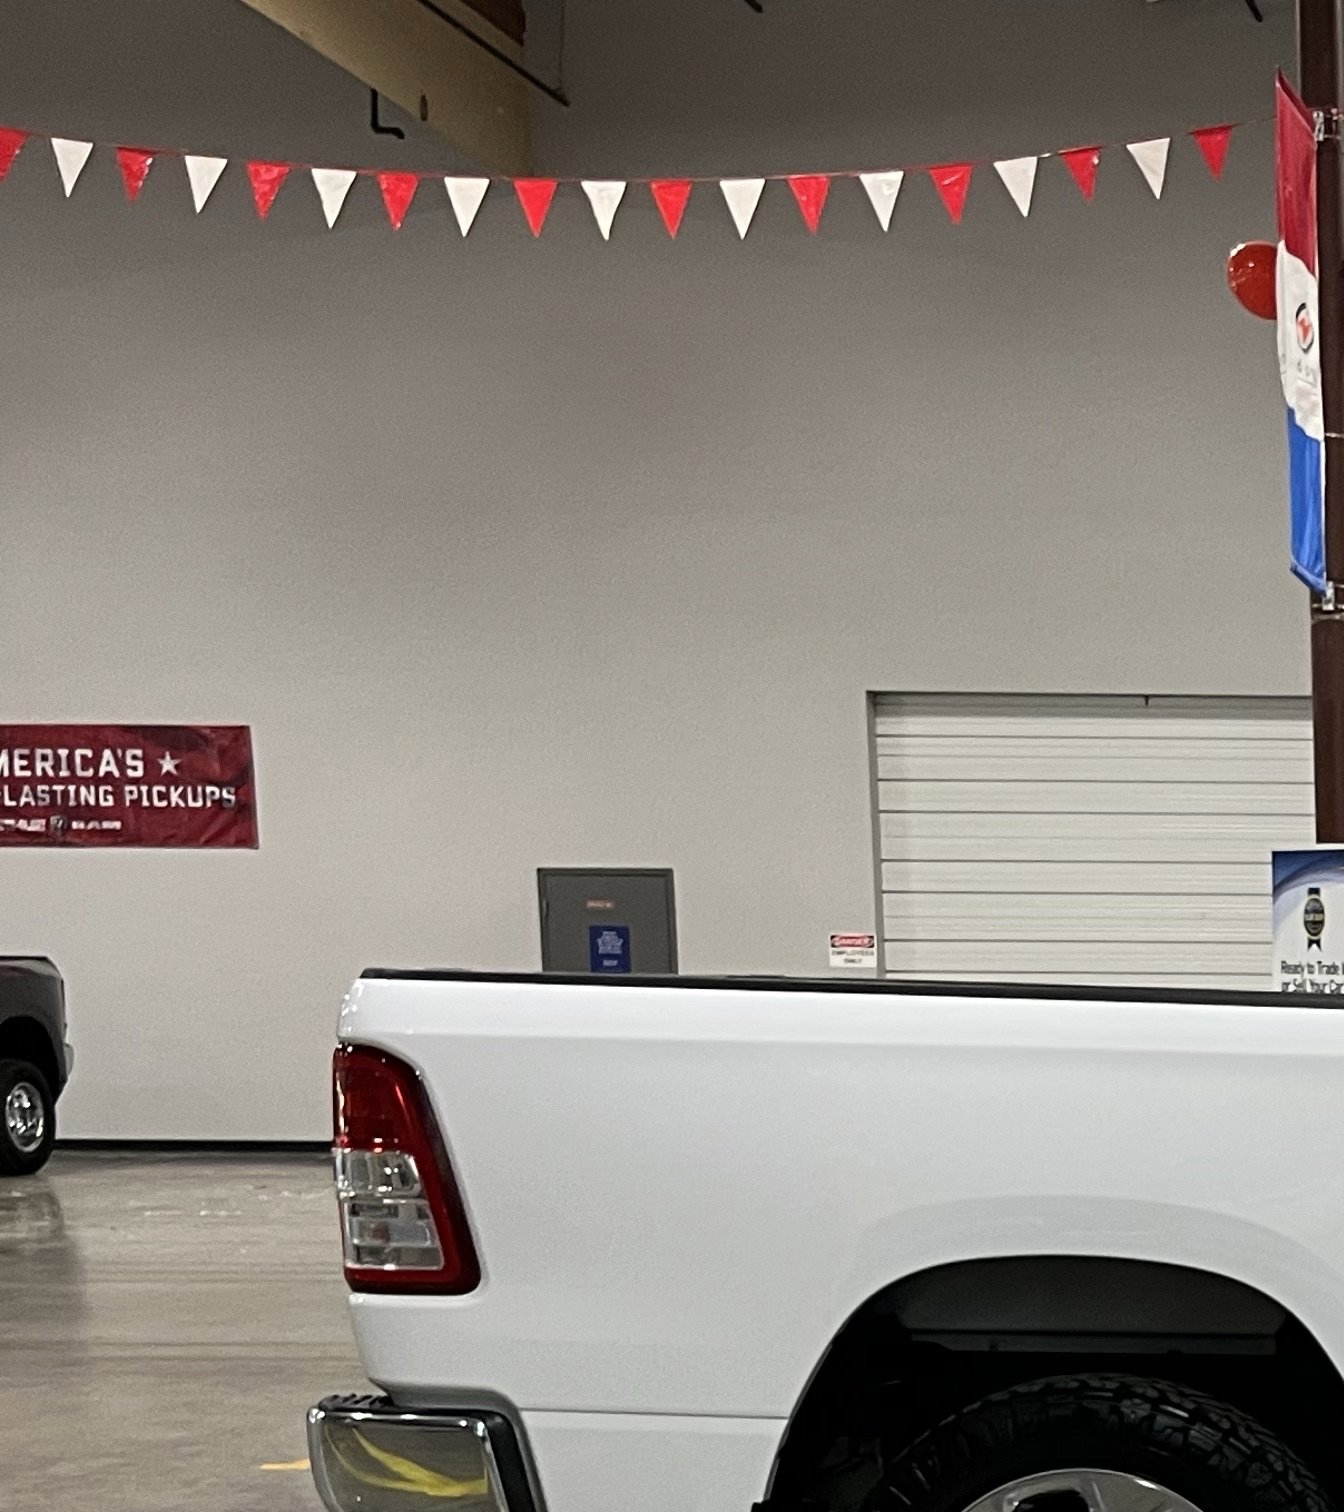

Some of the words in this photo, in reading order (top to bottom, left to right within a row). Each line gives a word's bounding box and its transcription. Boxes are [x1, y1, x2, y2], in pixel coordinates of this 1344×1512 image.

[0, 784, 114, 807] LASTING
[124, 785, 236, 808] PICKUPS
[1281, 960, 1304, 978] Ready
[1307, 961, 1315, 975] to
[1317, 960, 1340, 976] Trade
[1293, 978, 1307, 993] Sell
[1309, 978, 1329, 994] Your
